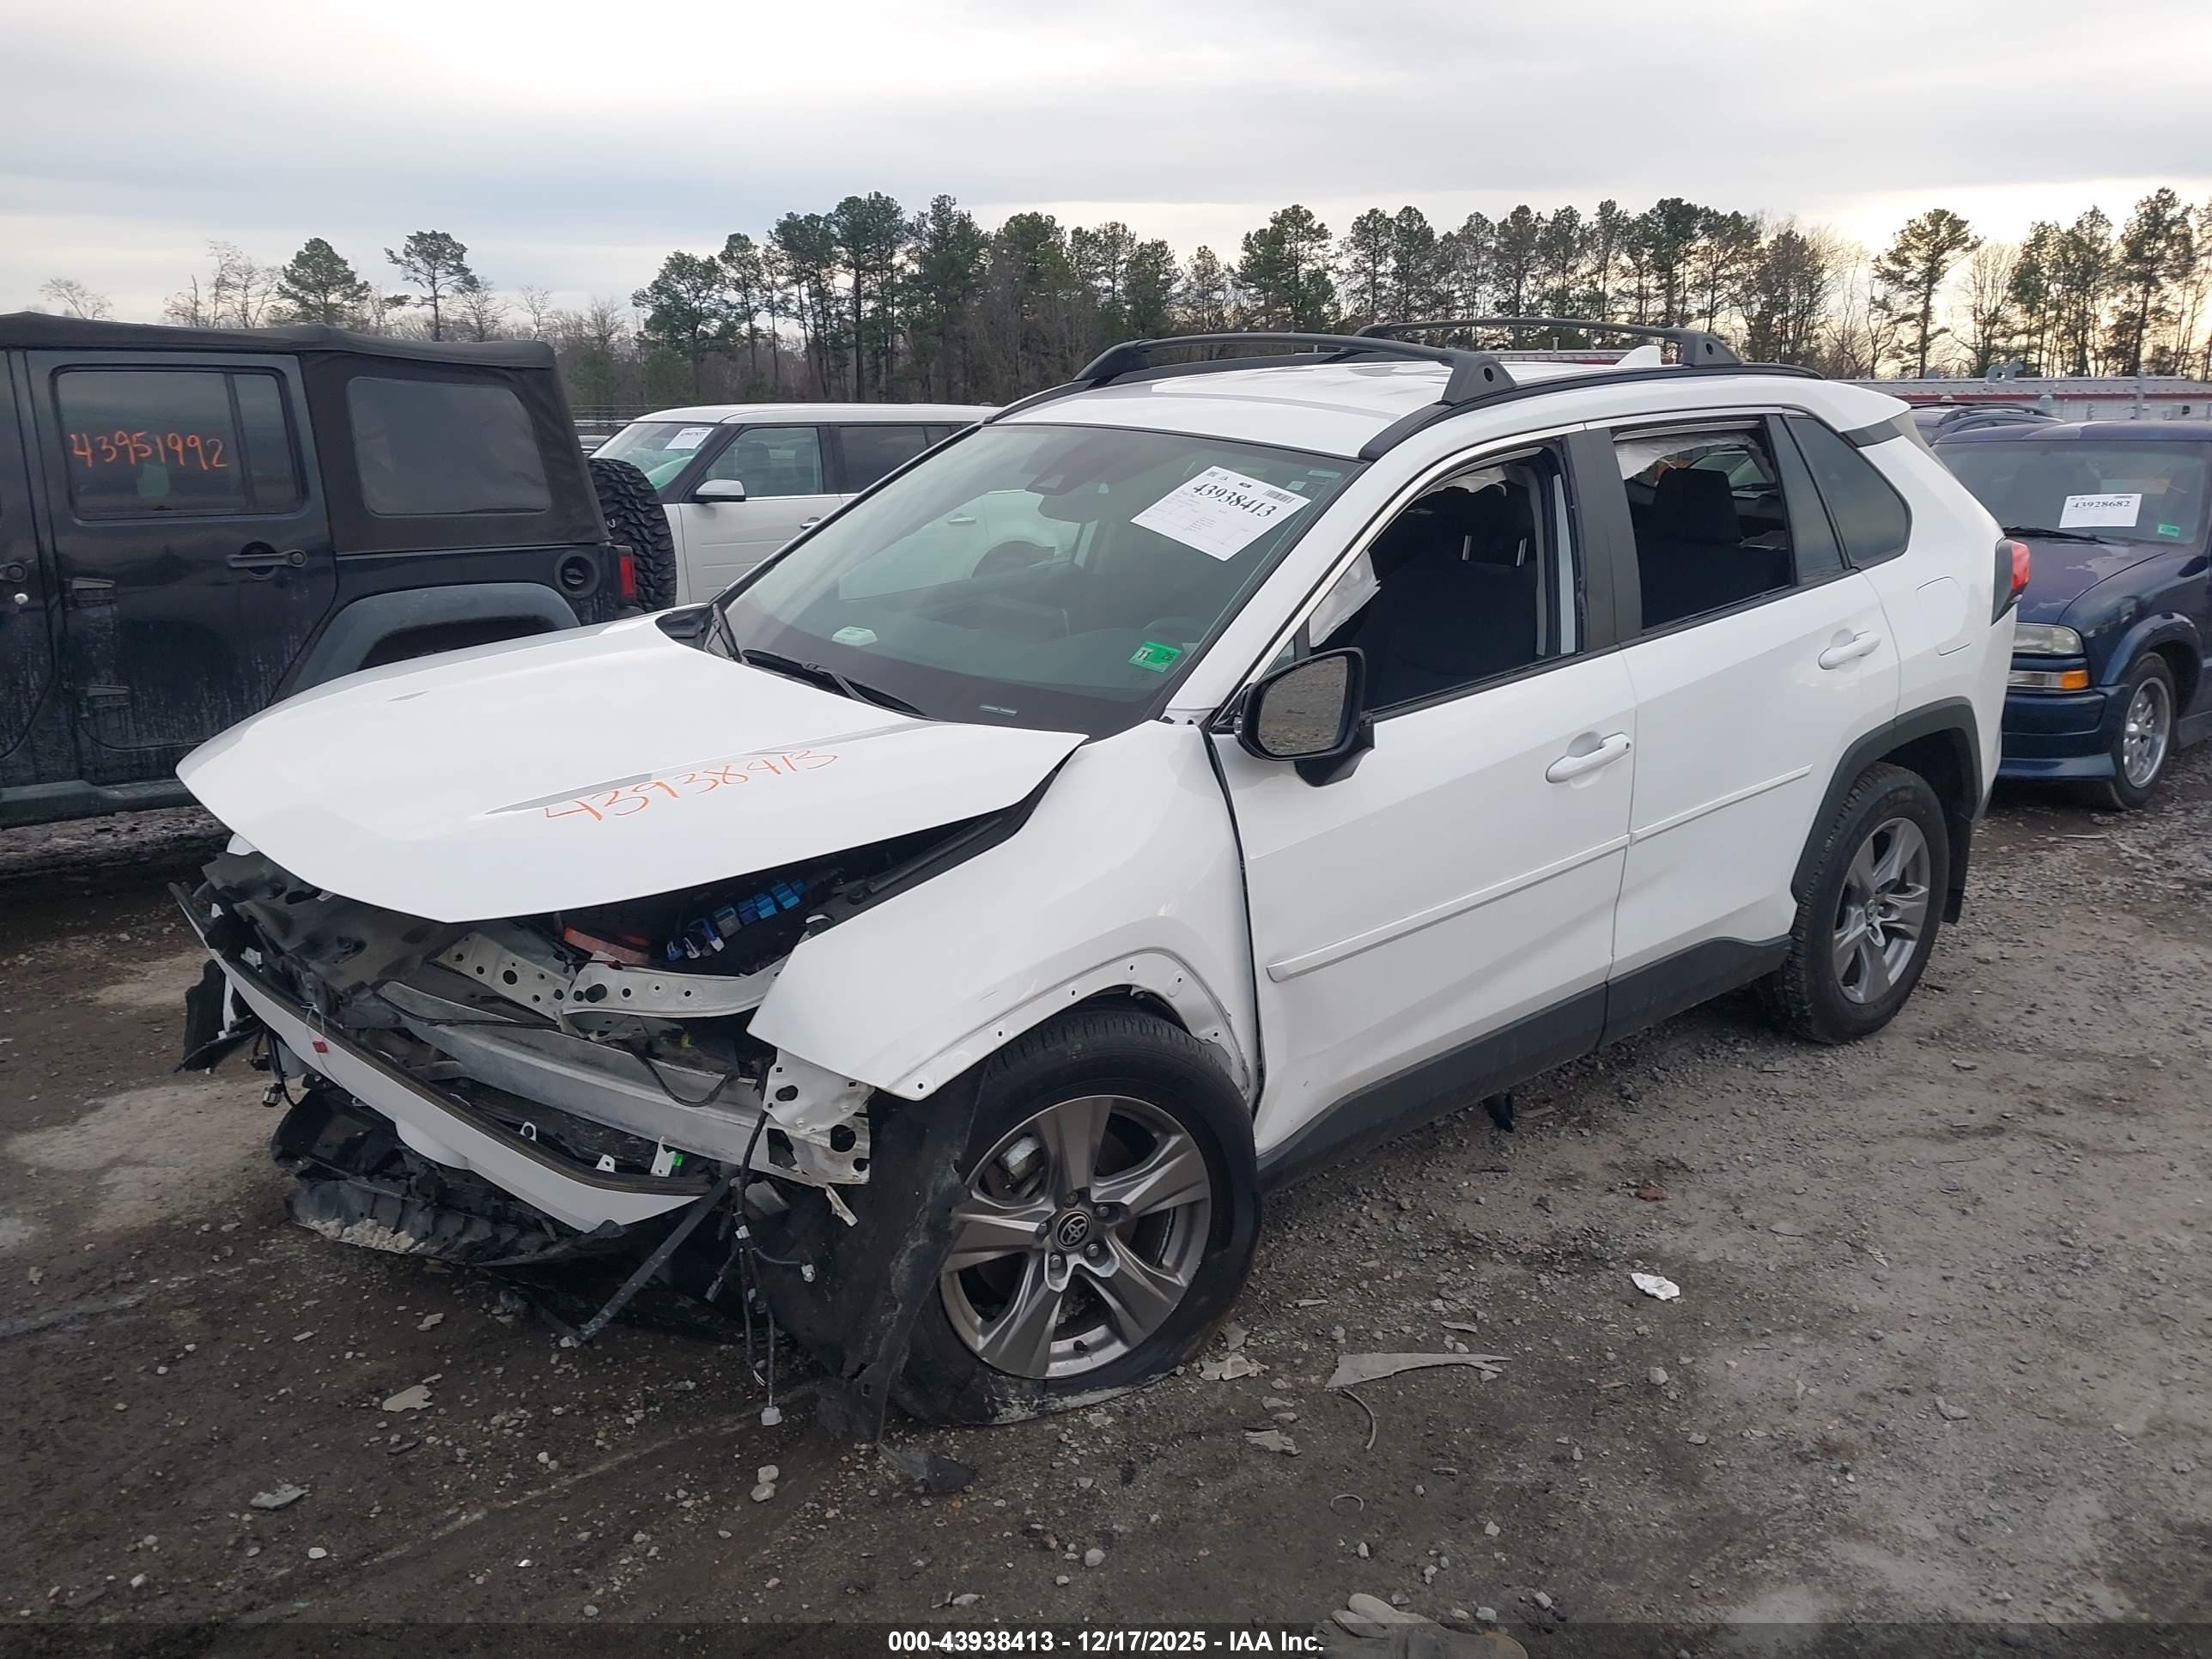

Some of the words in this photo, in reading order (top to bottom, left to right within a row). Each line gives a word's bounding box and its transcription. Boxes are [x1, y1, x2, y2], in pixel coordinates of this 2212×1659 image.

[70, 431, 227, 471] 43951992
[1193, 483, 1278, 518] 43938413
[544, 750, 838, 822] 43938413
